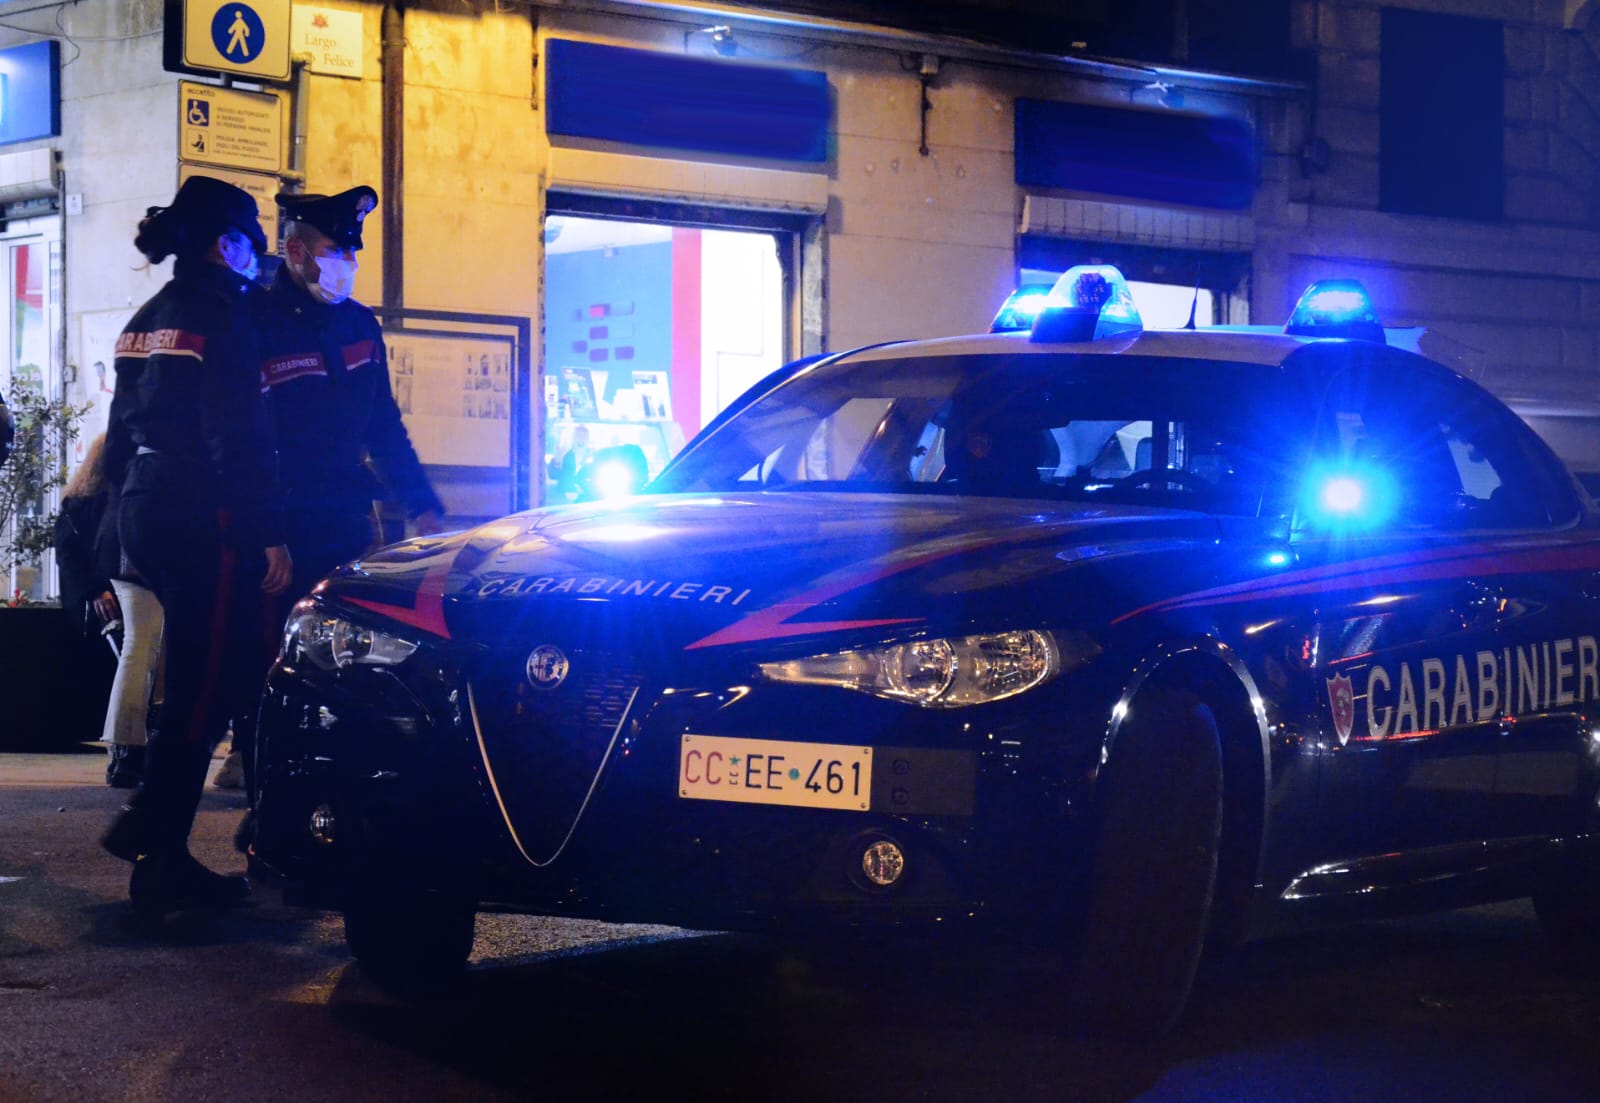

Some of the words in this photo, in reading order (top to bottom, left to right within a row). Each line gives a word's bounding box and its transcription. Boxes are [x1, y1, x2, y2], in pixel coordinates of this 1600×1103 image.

[305, 32, 337, 50] Largo
[324, 53, 354, 68] Felice
[478, 577, 752, 606] CARABINIERI
[1367, 635, 1600, 740] CARABINIER
[685, 749, 723, 785] CC
[745, 753, 785, 790] EE
[804, 758, 861, 796] 461
